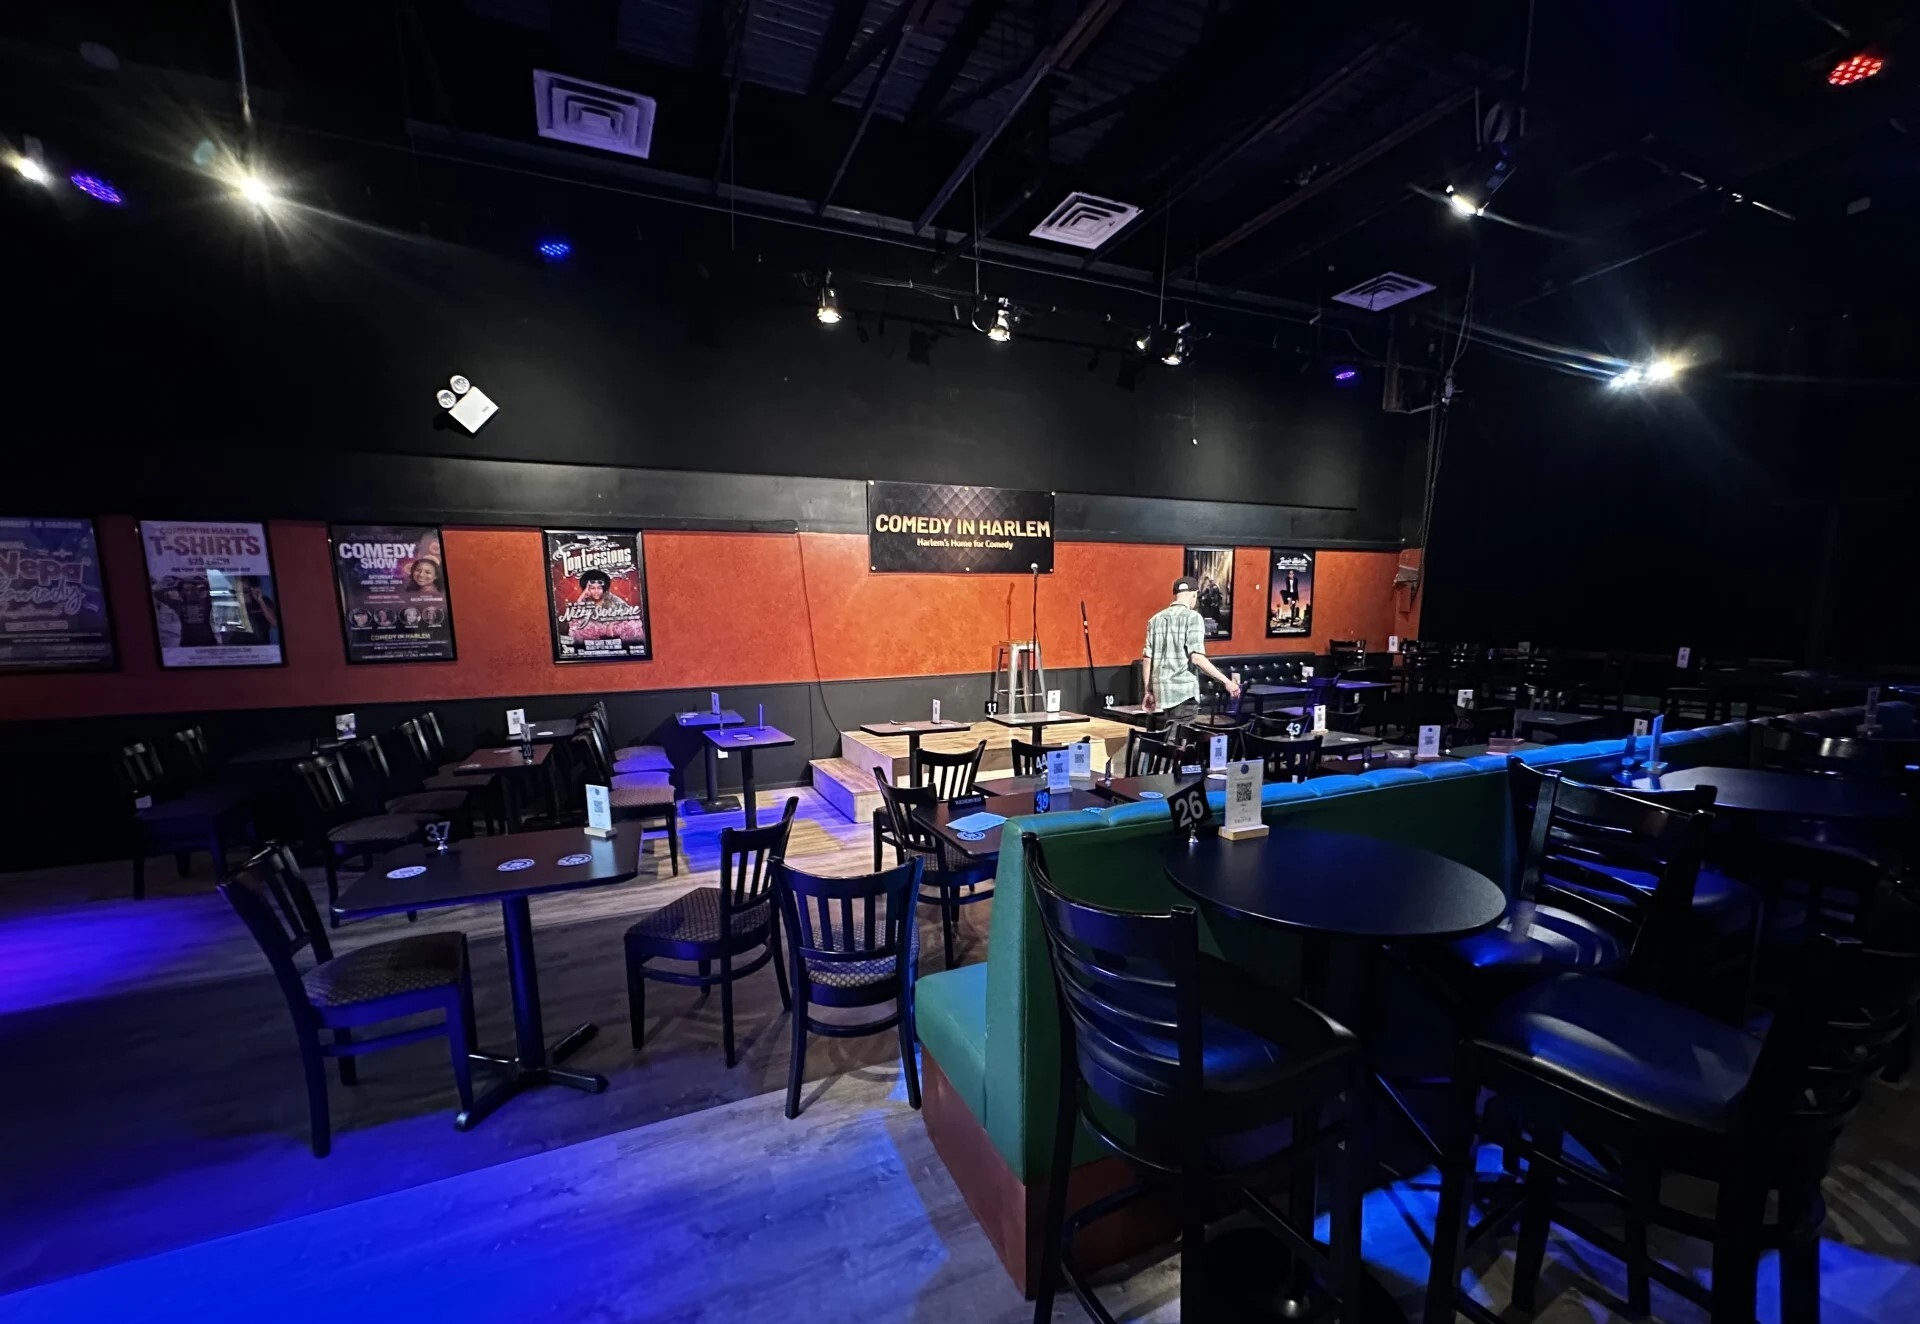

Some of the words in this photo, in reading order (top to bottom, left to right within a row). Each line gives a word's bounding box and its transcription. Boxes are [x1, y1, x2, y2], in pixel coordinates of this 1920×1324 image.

[875, 514, 951, 534] COMEDY
[957, 517, 975, 535] IN
[979, 520, 1051, 537] HARLEM
[149, 535, 261, 556] T-SHIRTS
[339, 543, 416, 559] COMEDY
[916, 538, 950, 547] Harlem's
[951, 539, 973, 548] Home
[974, 540, 984, 548] for
[985, 540, 1014, 550] Comedy
[361, 558, 398, 569] SHOW
[1105, 695, 1114, 705] 10
[987, 703, 998, 713] 11
[1286, 722, 1301, 735] 43
[523, 745, 533, 757] 20
[1036, 793, 1049, 812] 38
[1175, 790, 1204, 828] 26
[426, 821, 451, 842] 37
